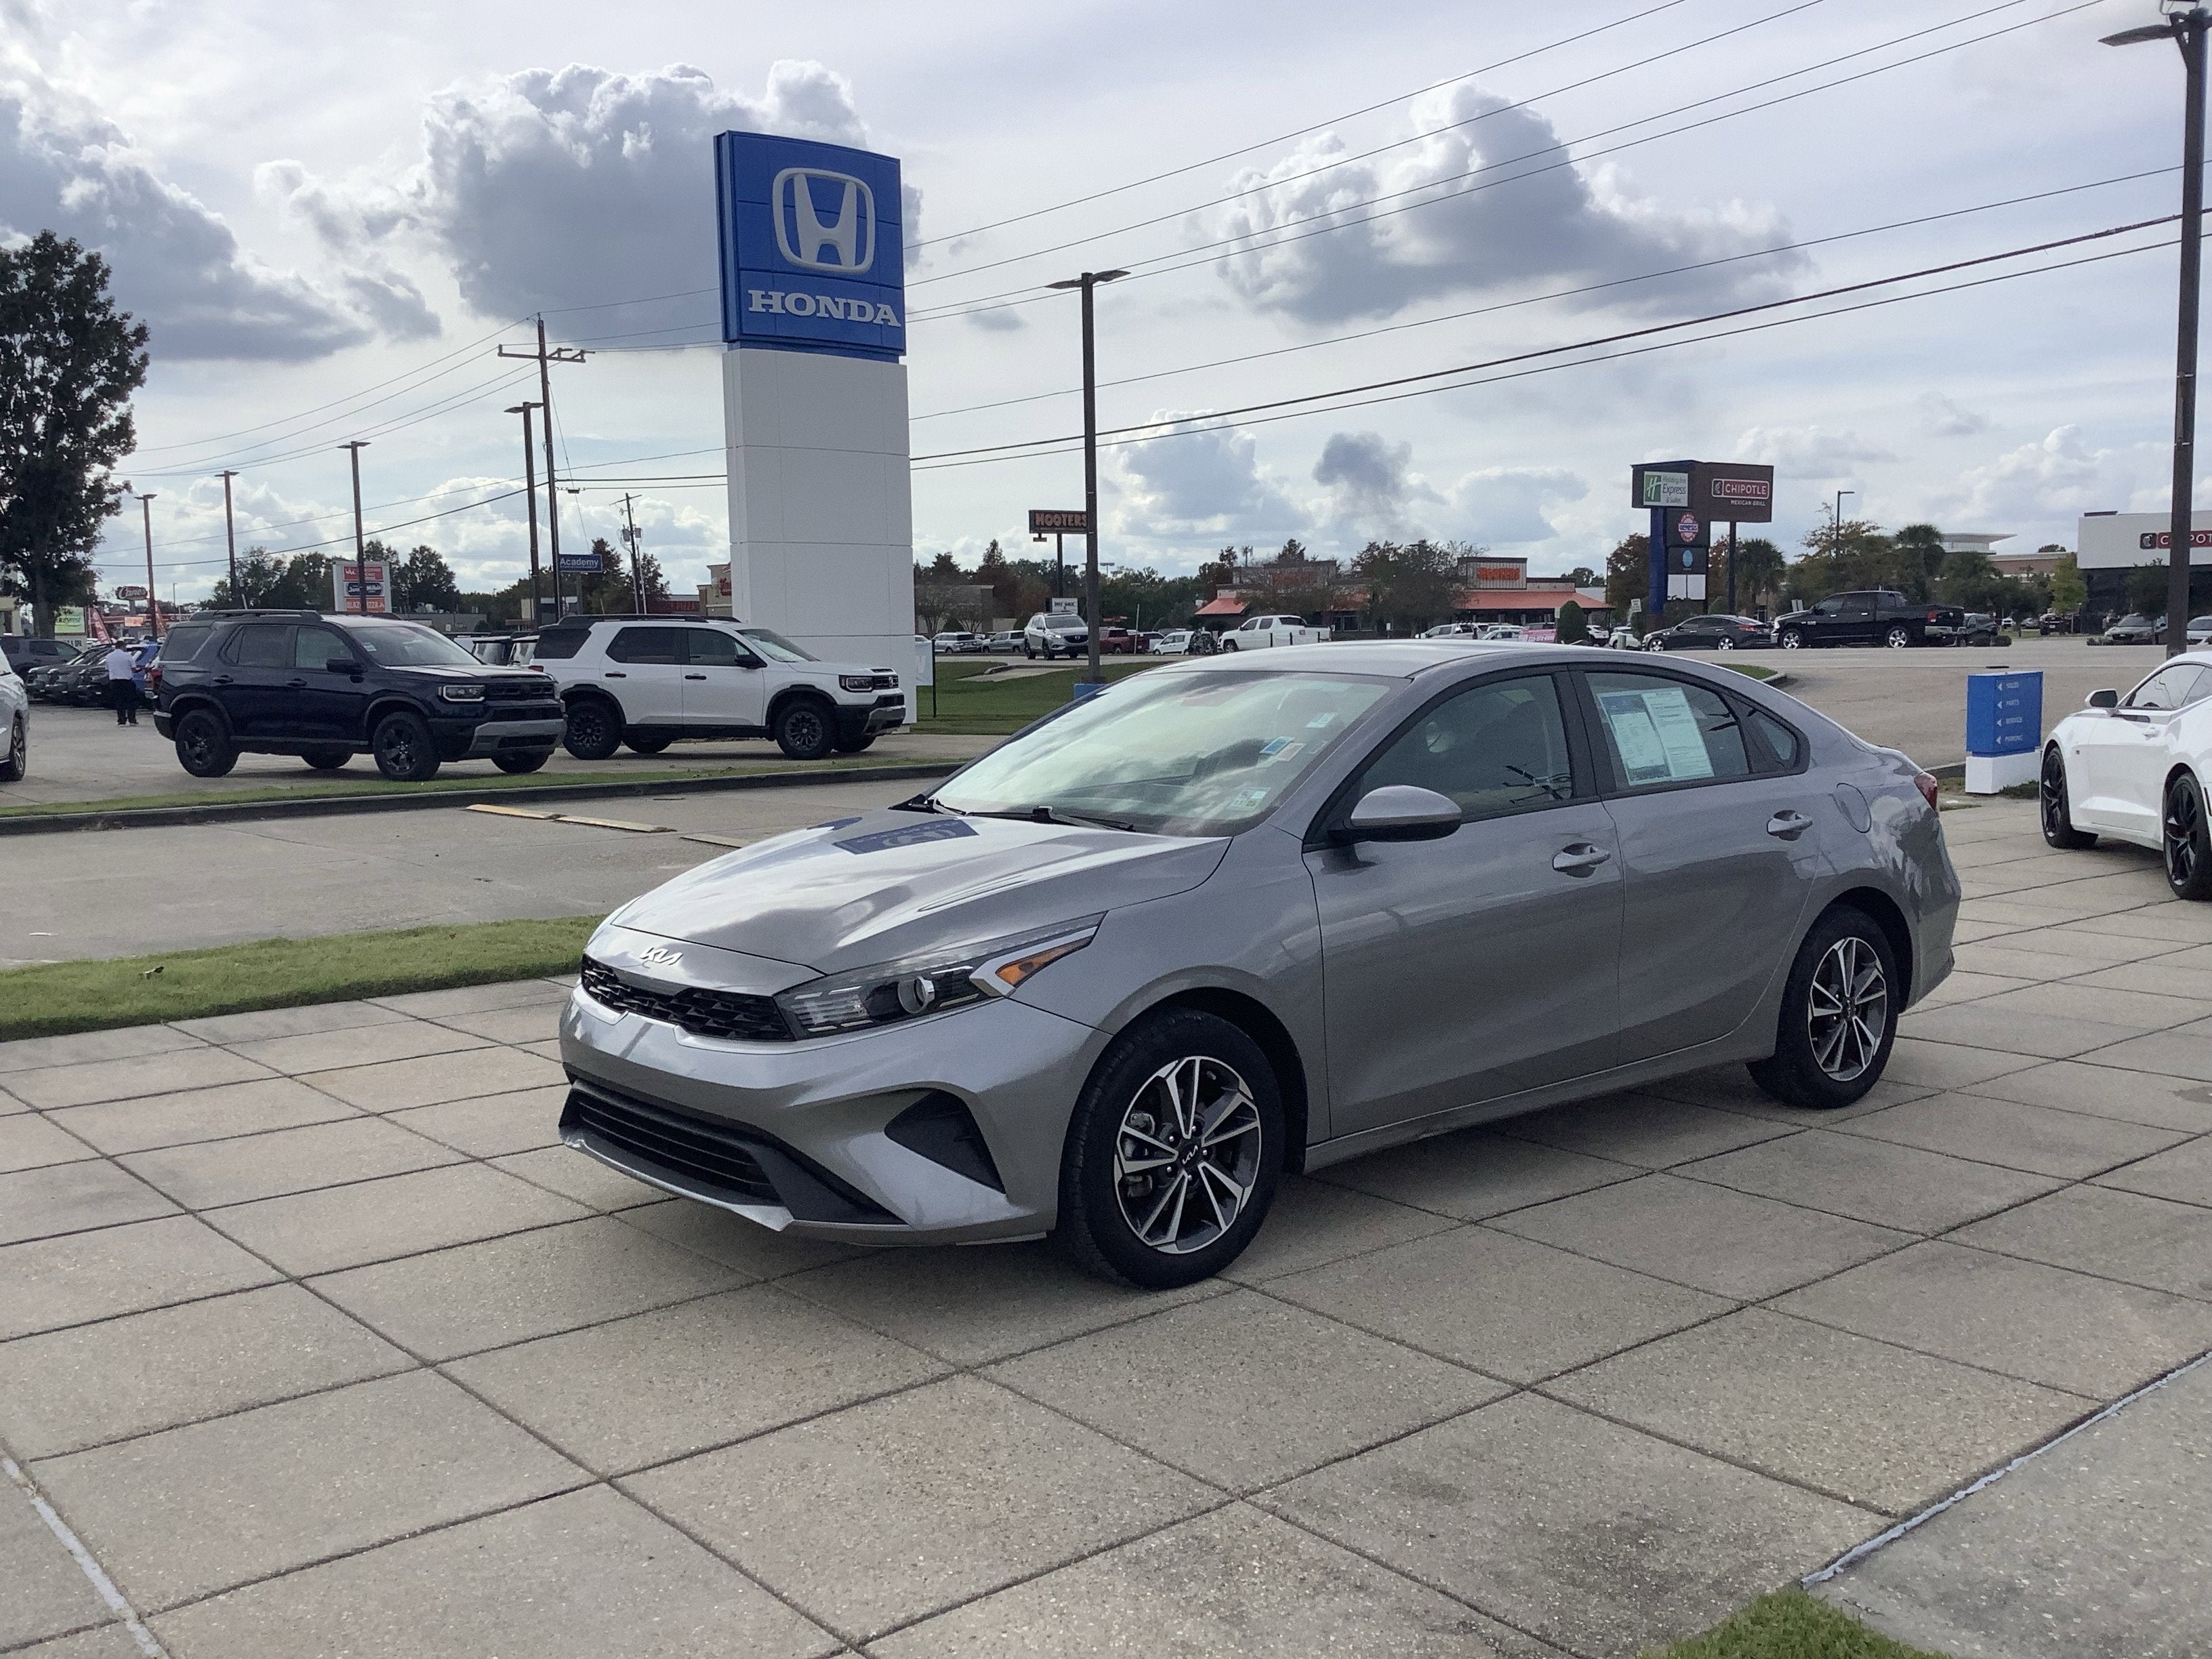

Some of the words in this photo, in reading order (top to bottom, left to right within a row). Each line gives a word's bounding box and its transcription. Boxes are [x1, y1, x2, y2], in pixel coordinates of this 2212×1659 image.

[747, 289, 902, 327] HONDA
[1662, 483, 1687, 495] Express
[1725, 483, 1767, 495] CHIPOTLE
[1035, 512, 1086, 527] HOOTERS
[560, 558, 598, 568] Academy
[2005, 735, 2023, 743] PARKING
